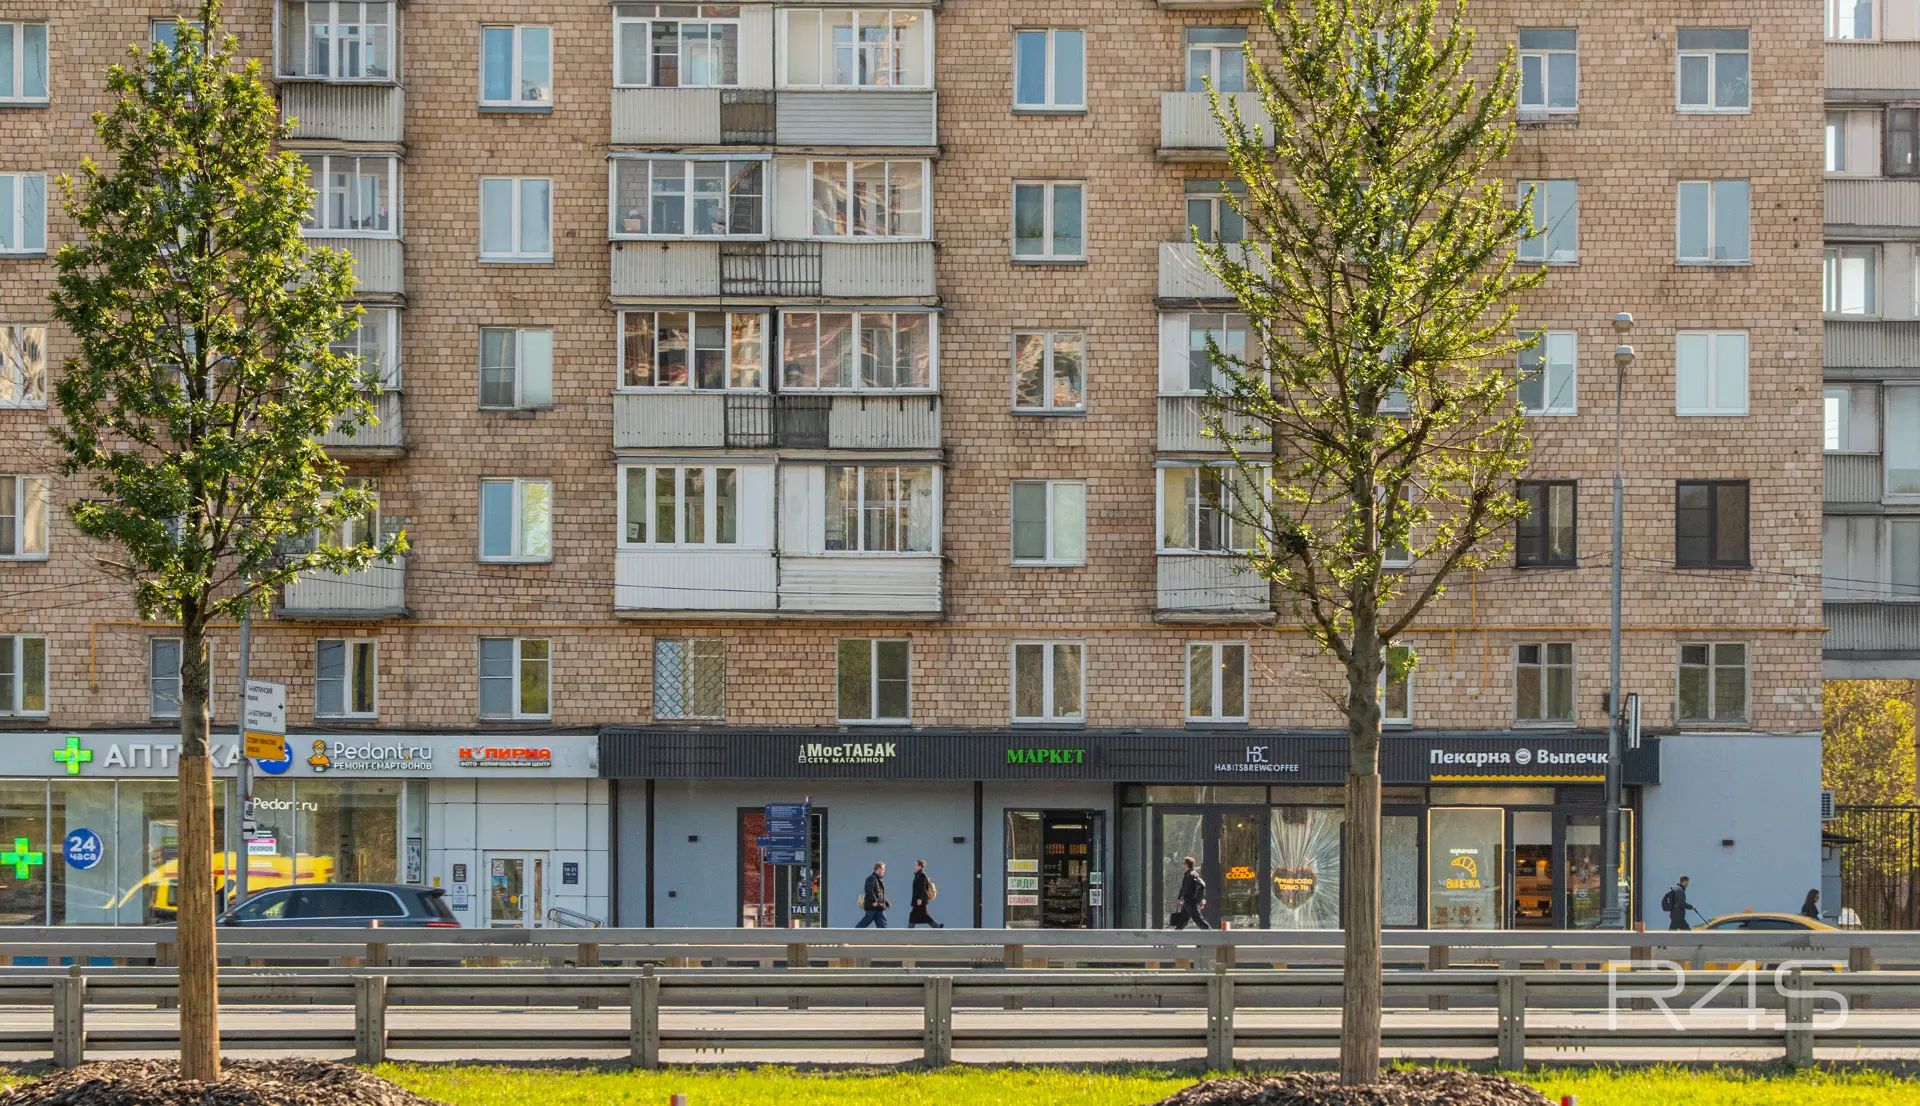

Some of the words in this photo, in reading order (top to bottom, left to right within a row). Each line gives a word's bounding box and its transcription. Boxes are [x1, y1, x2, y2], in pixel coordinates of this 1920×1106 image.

[103, 744, 239, 768] АПТКА
[333, 742, 432, 760] Pedant.ru
[807, 742, 896, 757] МосТАБАК
[1007, 749, 1085, 764] МАРКЕТ
[1430, 748, 1511, 767] Пекарня
[1537, 749, 1608, 764] Выпечк
[334, 762, 369, 770] РЕМОНТ
[371, 762, 432, 770] СМАРТФОНОВ
[1214, 763, 1299, 772] HABITSBREWCOFFEE
[69, 836, 96, 852] 24
[69, 852, 97, 861] часа
[1011, 878, 1035, 889] СИДР
